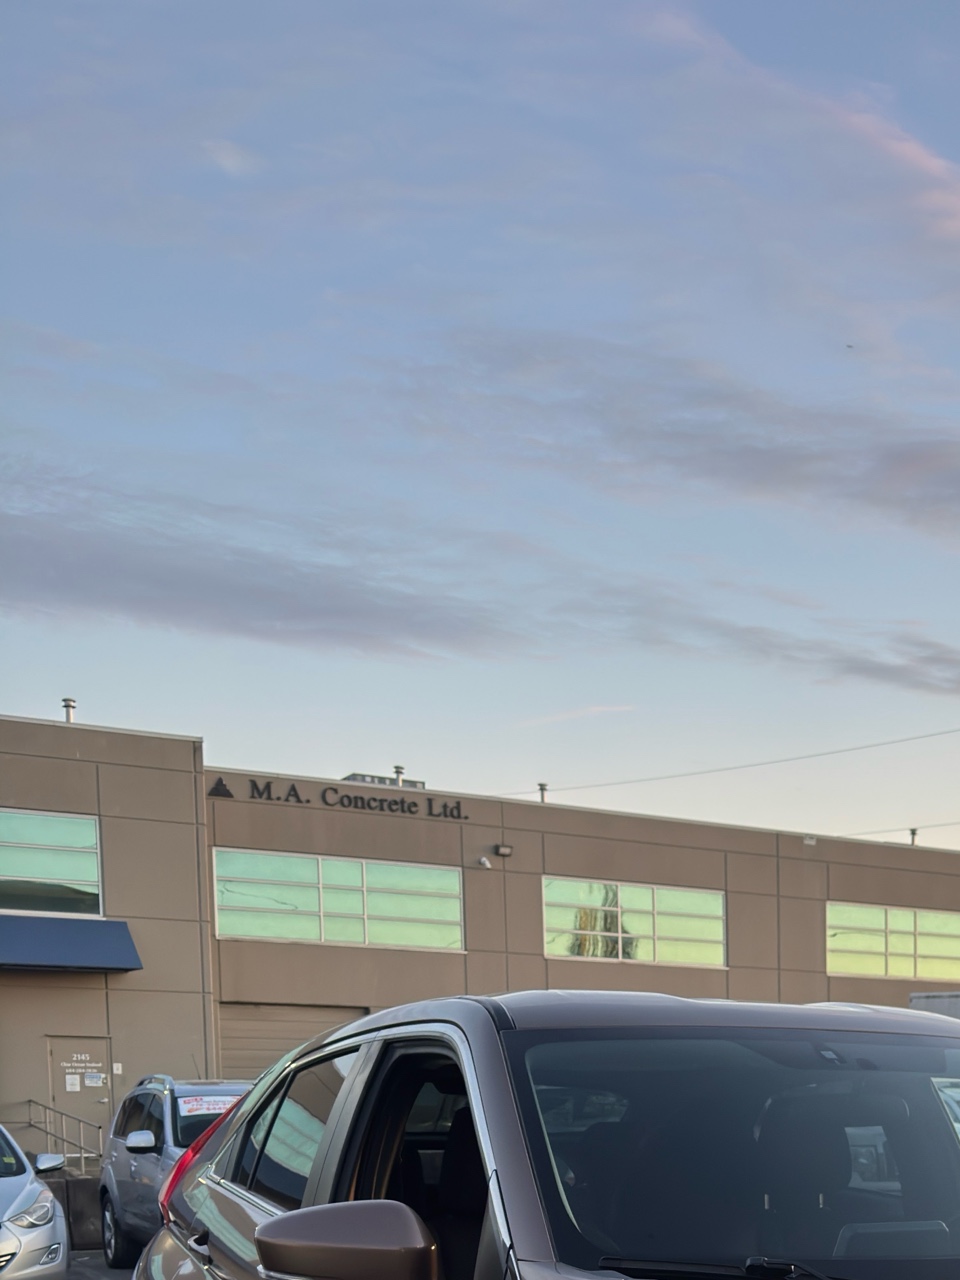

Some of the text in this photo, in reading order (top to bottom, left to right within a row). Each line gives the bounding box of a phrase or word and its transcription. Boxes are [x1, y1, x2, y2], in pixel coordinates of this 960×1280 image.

[249, 779, 469, 820] M.A. Concrete Ltd.
[72, 1053, 90, 1061] 2145
